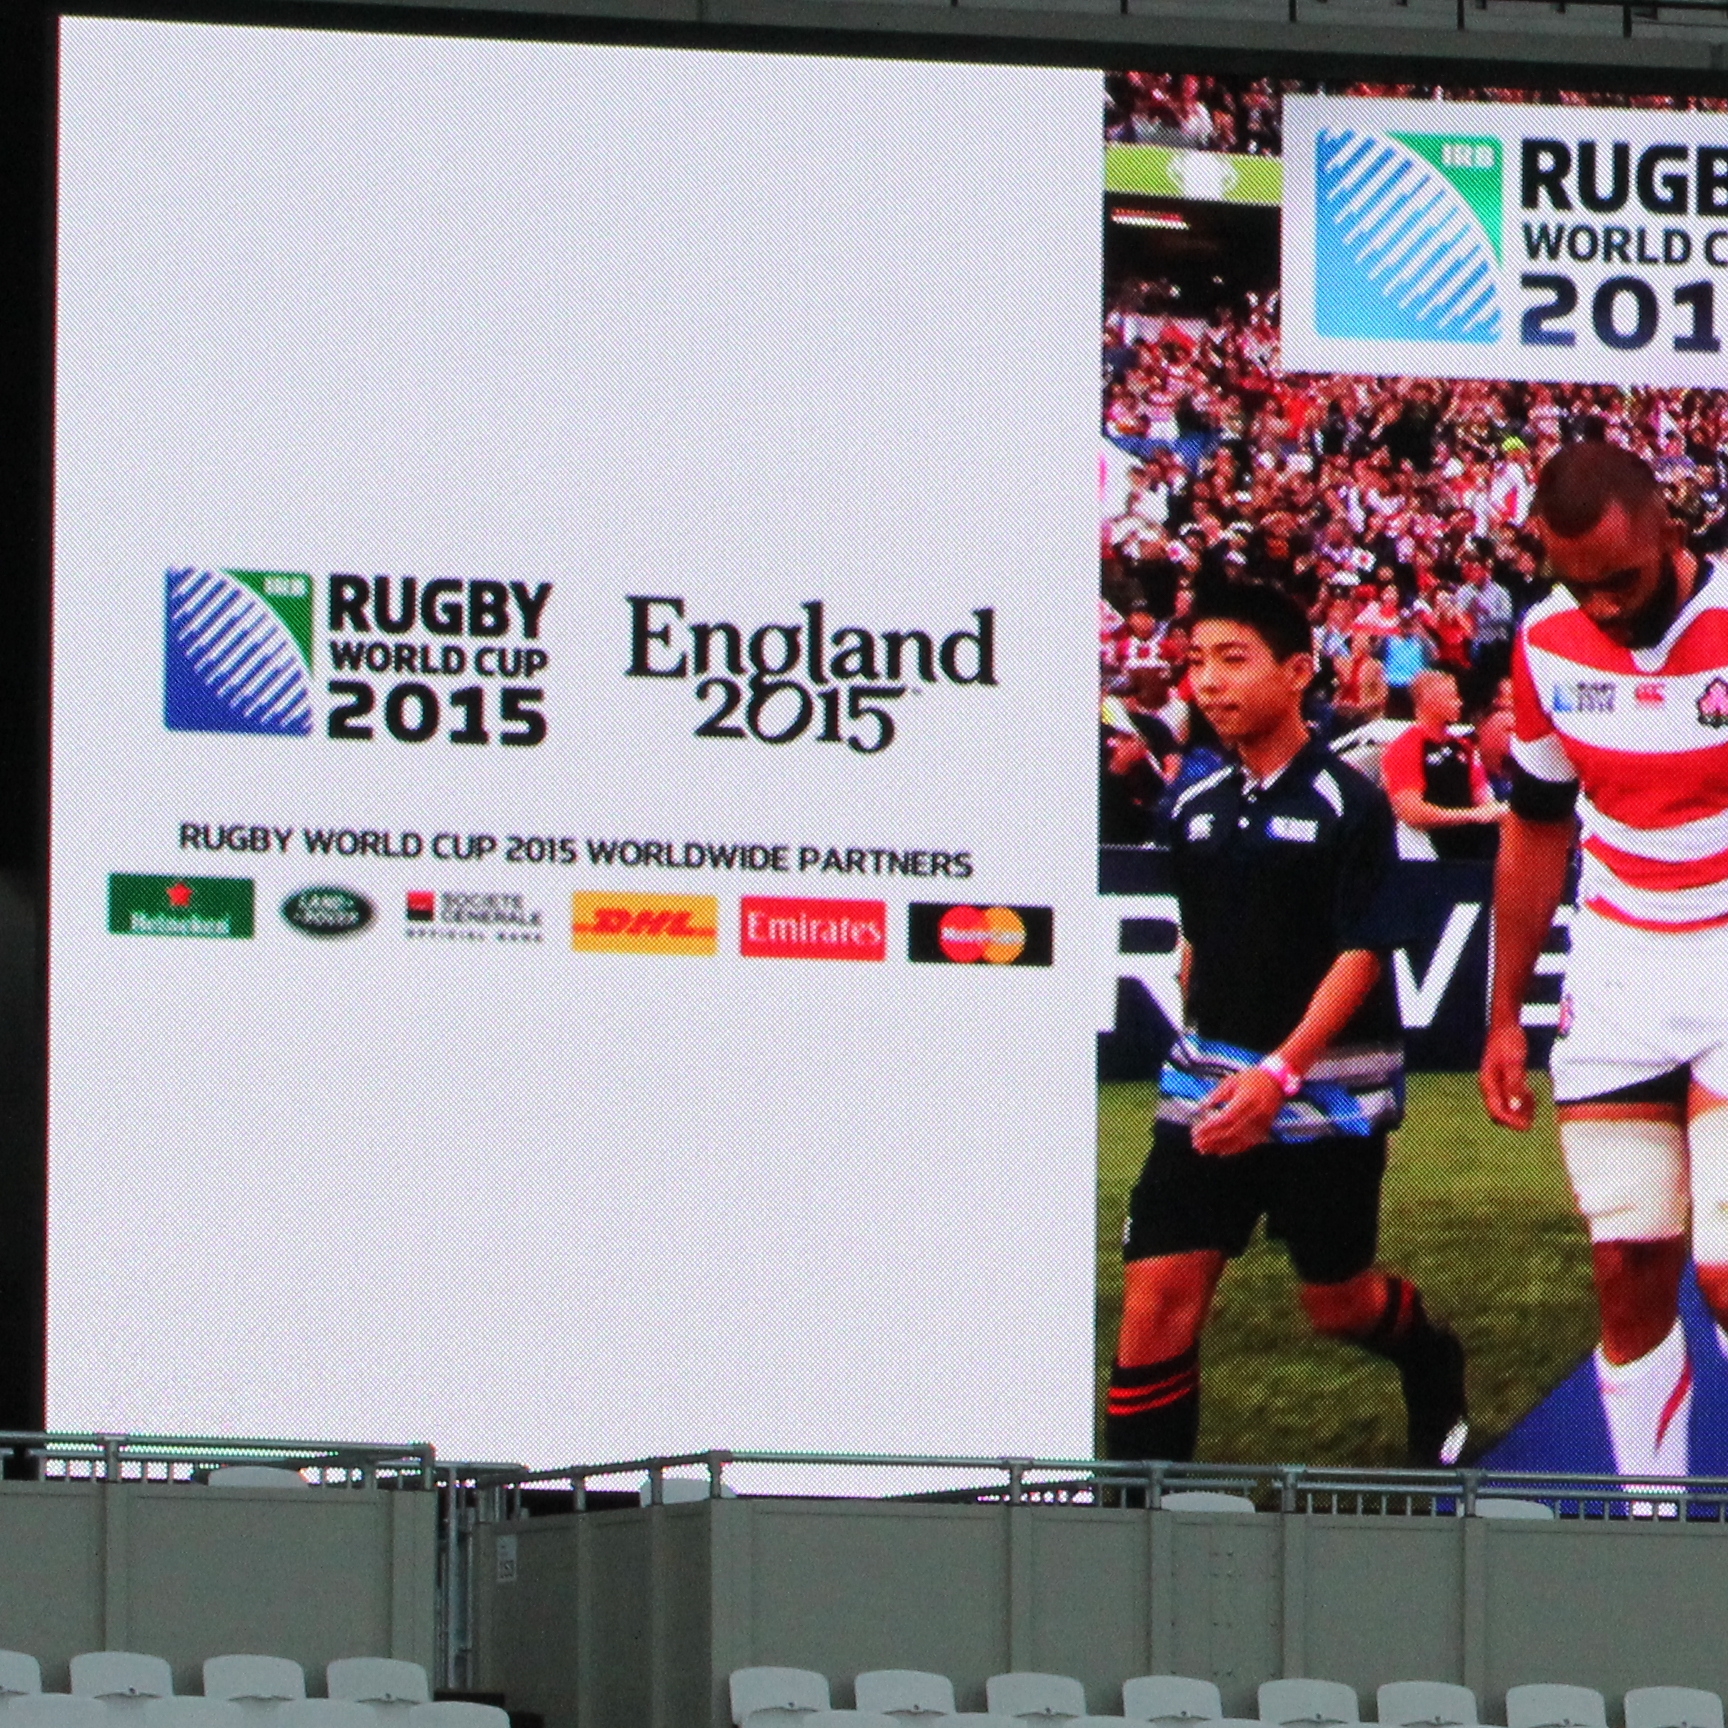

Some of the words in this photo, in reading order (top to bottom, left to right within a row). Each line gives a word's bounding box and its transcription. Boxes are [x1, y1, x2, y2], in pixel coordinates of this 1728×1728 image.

[1522, 223, 1691, 267] WORLD
[328, 572, 553, 639] RUGBY
[329, 641, 466, 676] WORLD
[475, 646, 548, 678] CUP
[623, 594, 999, 689] England
[328, 679, 548, 747] 2015
[694, 677, 905, 754] 2015
[180, 821, 294, 854] RUGBY
[304, 827, 423, 858] WORLD
[433, 832, 496, 860] CUP
[506, 836, 577, 864] 2015
[588, 839, 788, 872] WORLDWIDE
[800, 845, 974, 878] PARTNERS
[593, 909, 698, 938] DHL
[747, 911, 882, 945] Emirates
